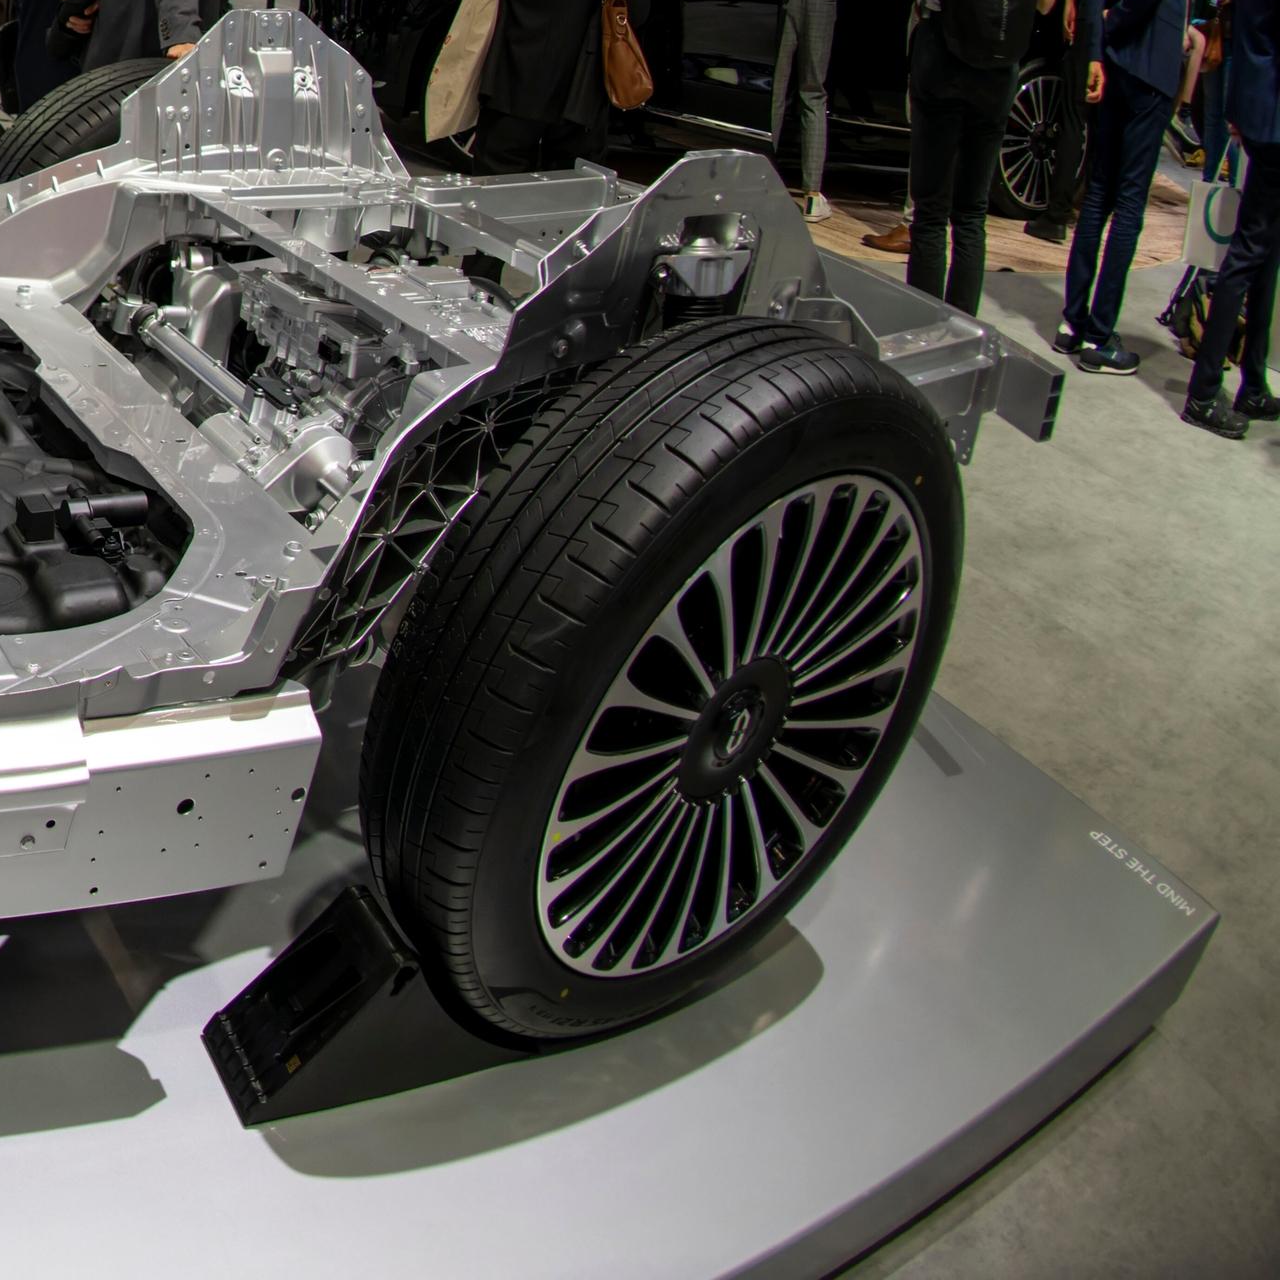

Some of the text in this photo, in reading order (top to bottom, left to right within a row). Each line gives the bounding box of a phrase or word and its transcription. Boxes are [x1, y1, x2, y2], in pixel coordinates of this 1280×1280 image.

[1089, 830, 1196, 916] MIND THE STEP
